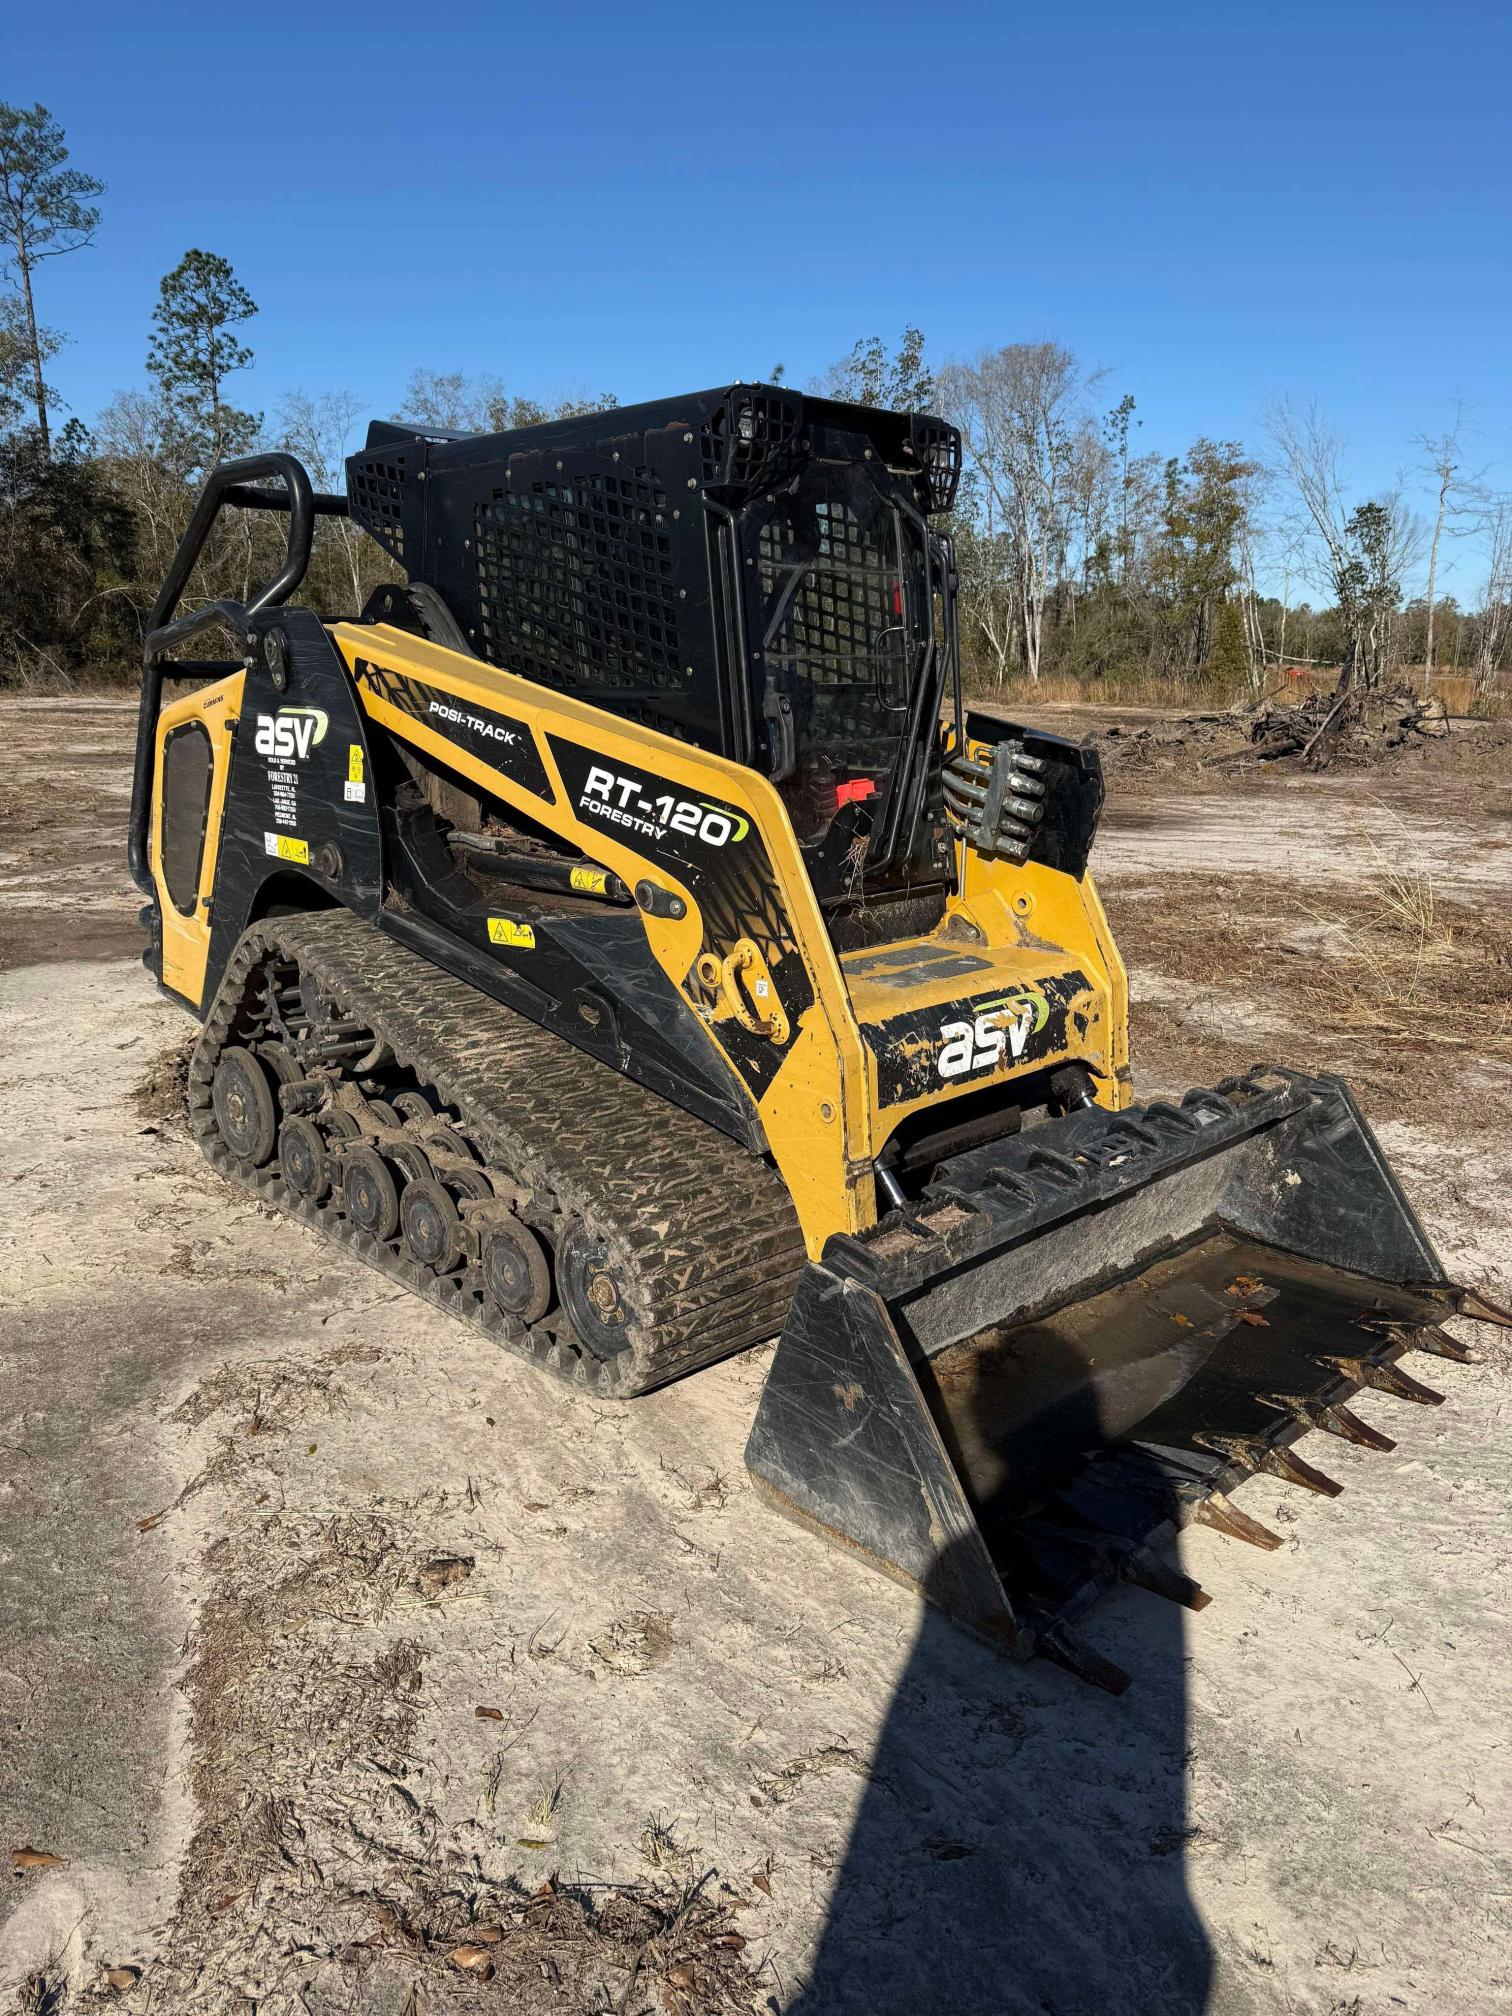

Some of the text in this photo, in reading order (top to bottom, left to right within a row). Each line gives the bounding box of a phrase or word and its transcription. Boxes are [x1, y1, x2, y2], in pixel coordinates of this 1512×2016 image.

[429, 701, 516, 746] POSI-TRACK
[579, 796, 668, 840] FORESTRY
[584, 766, 731, 847] RT-120
